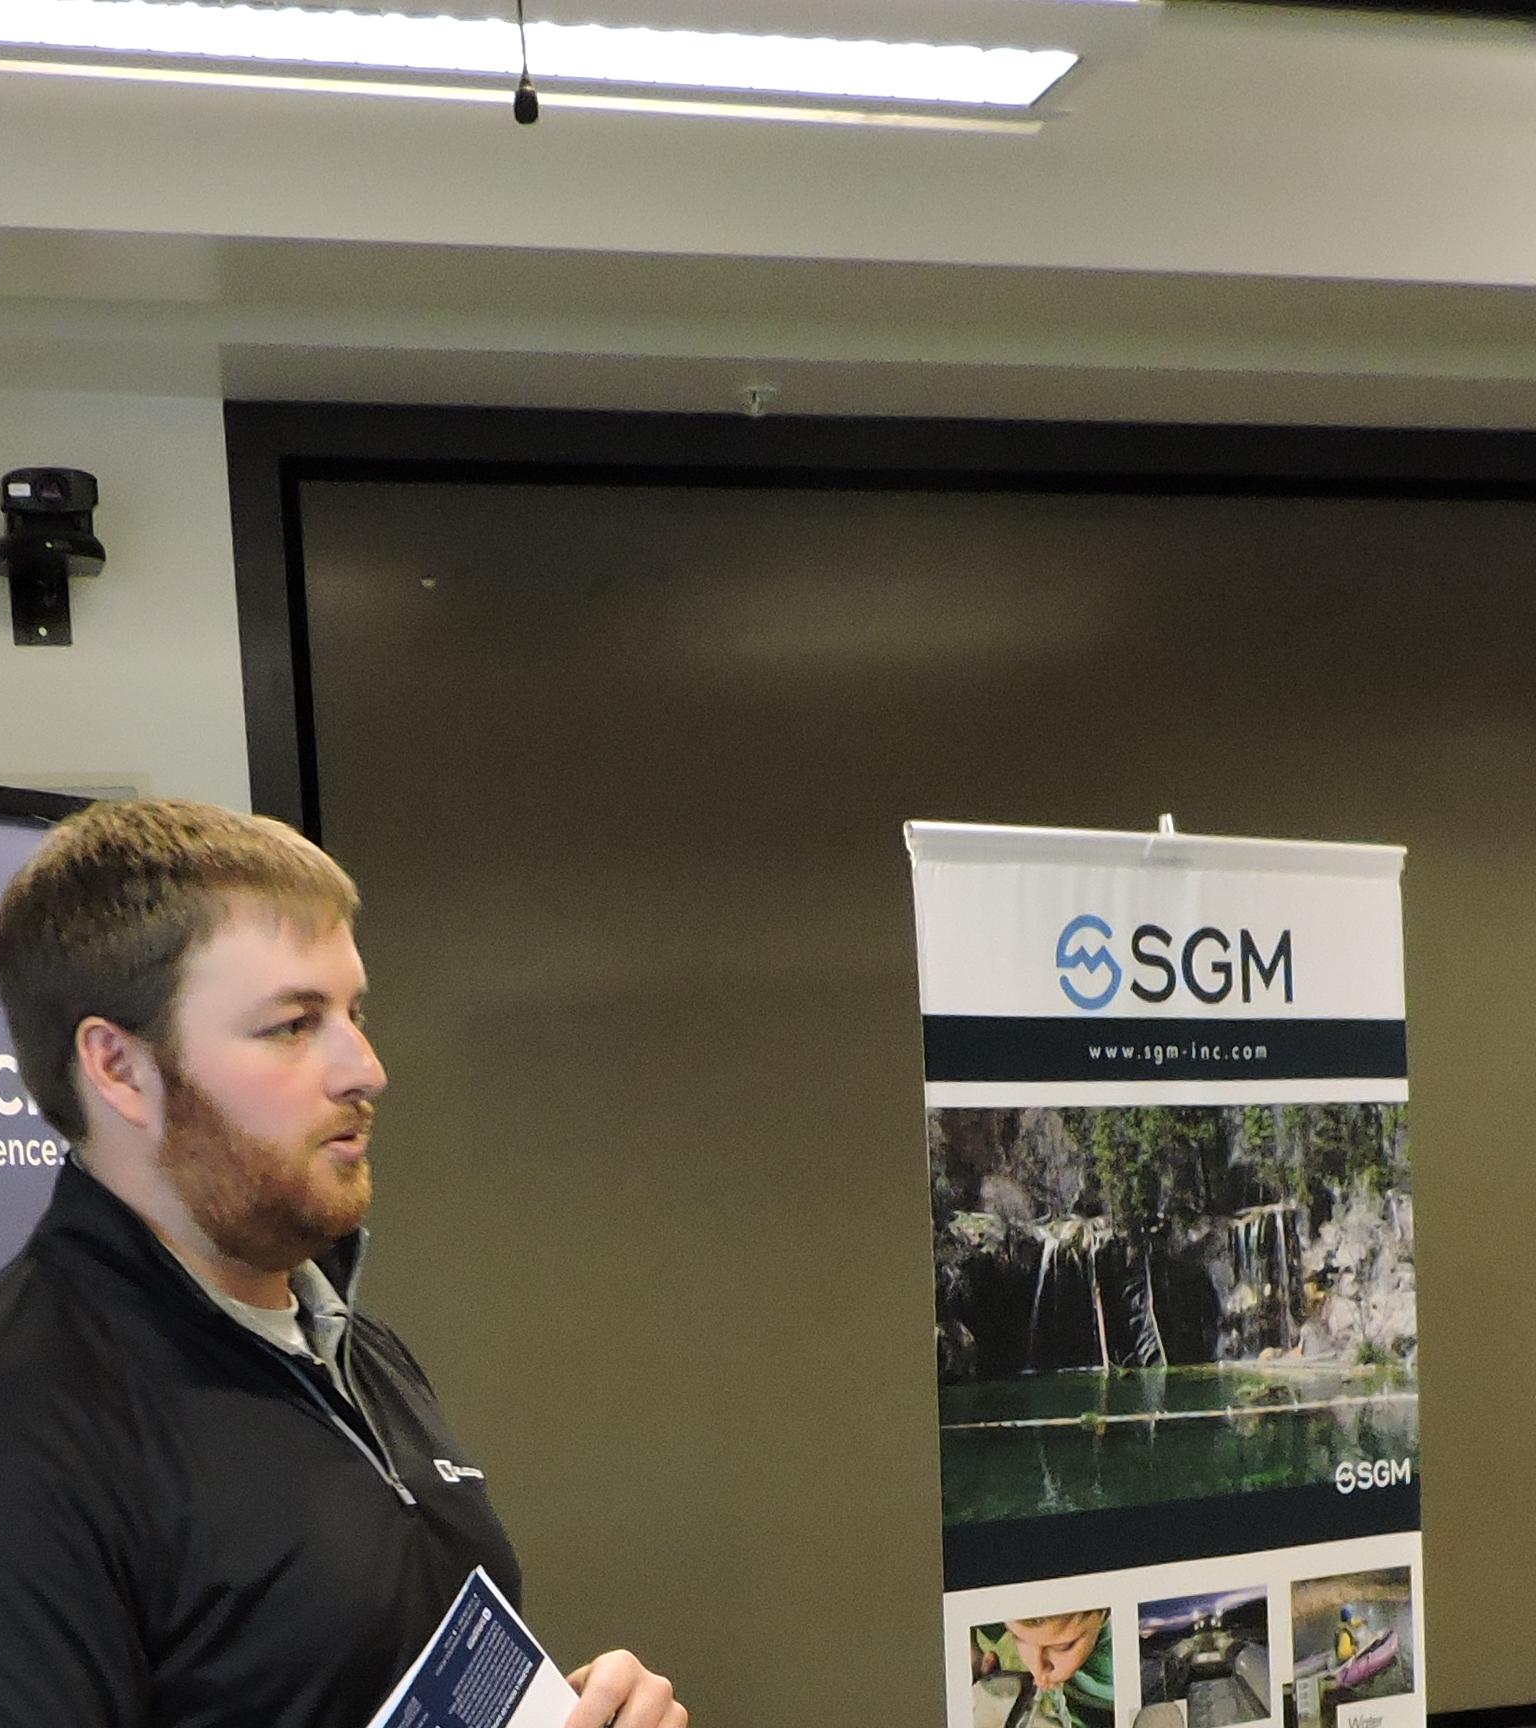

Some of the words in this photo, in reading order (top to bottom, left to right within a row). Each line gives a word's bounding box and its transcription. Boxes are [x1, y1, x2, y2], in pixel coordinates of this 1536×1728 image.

[1131, 924, 1293, 1004] SGM
[1089, 1041, 1268, 1065] www.sgm-inc.com
[1357, 1458, 1411, 1490] SGM
